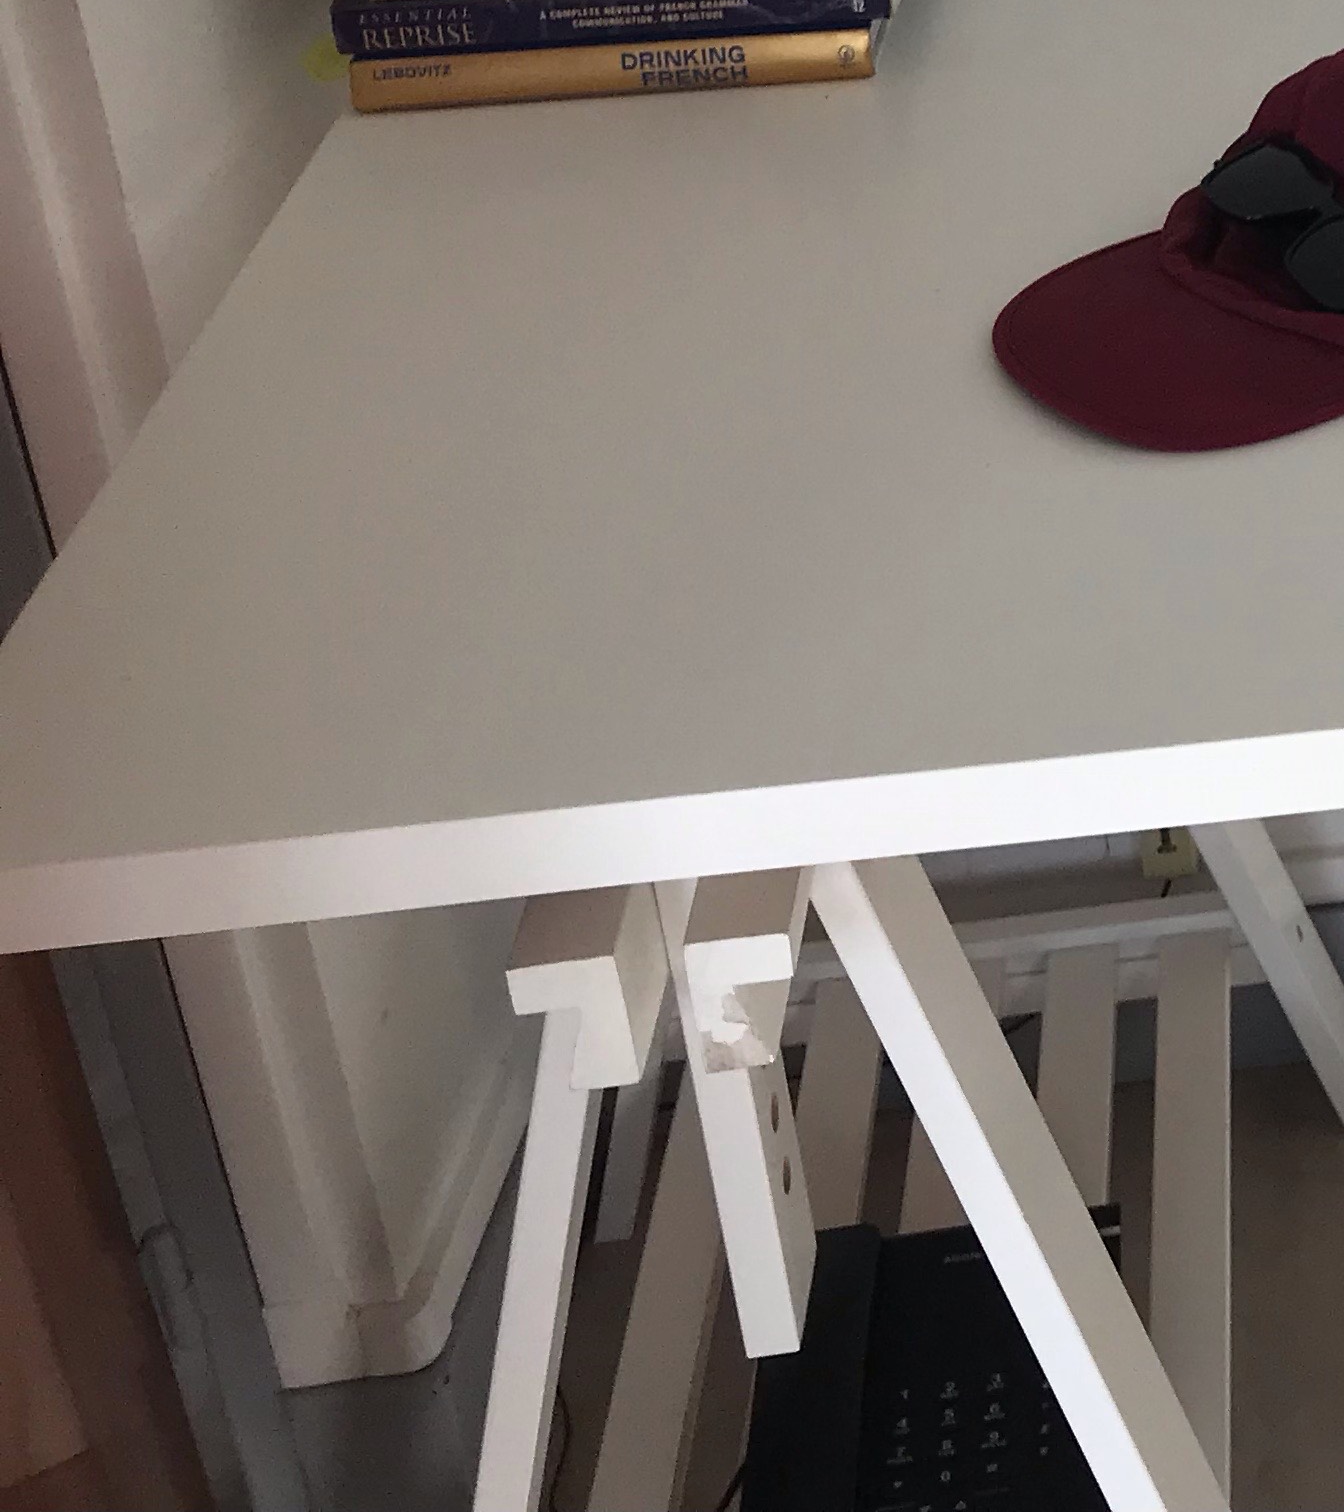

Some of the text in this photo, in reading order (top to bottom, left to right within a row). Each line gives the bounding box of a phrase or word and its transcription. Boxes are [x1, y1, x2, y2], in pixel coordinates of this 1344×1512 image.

[360, 6, 472, 26] ESSENTIAL
[539, 9, 547, 21] A
[362, 22, 477, 51] REPRISE
[620, 44, 747, 72] DRINKING
[373, 62, 454, 82] LEBOVITZ
[640, 64, 749, 88] FRENCH
